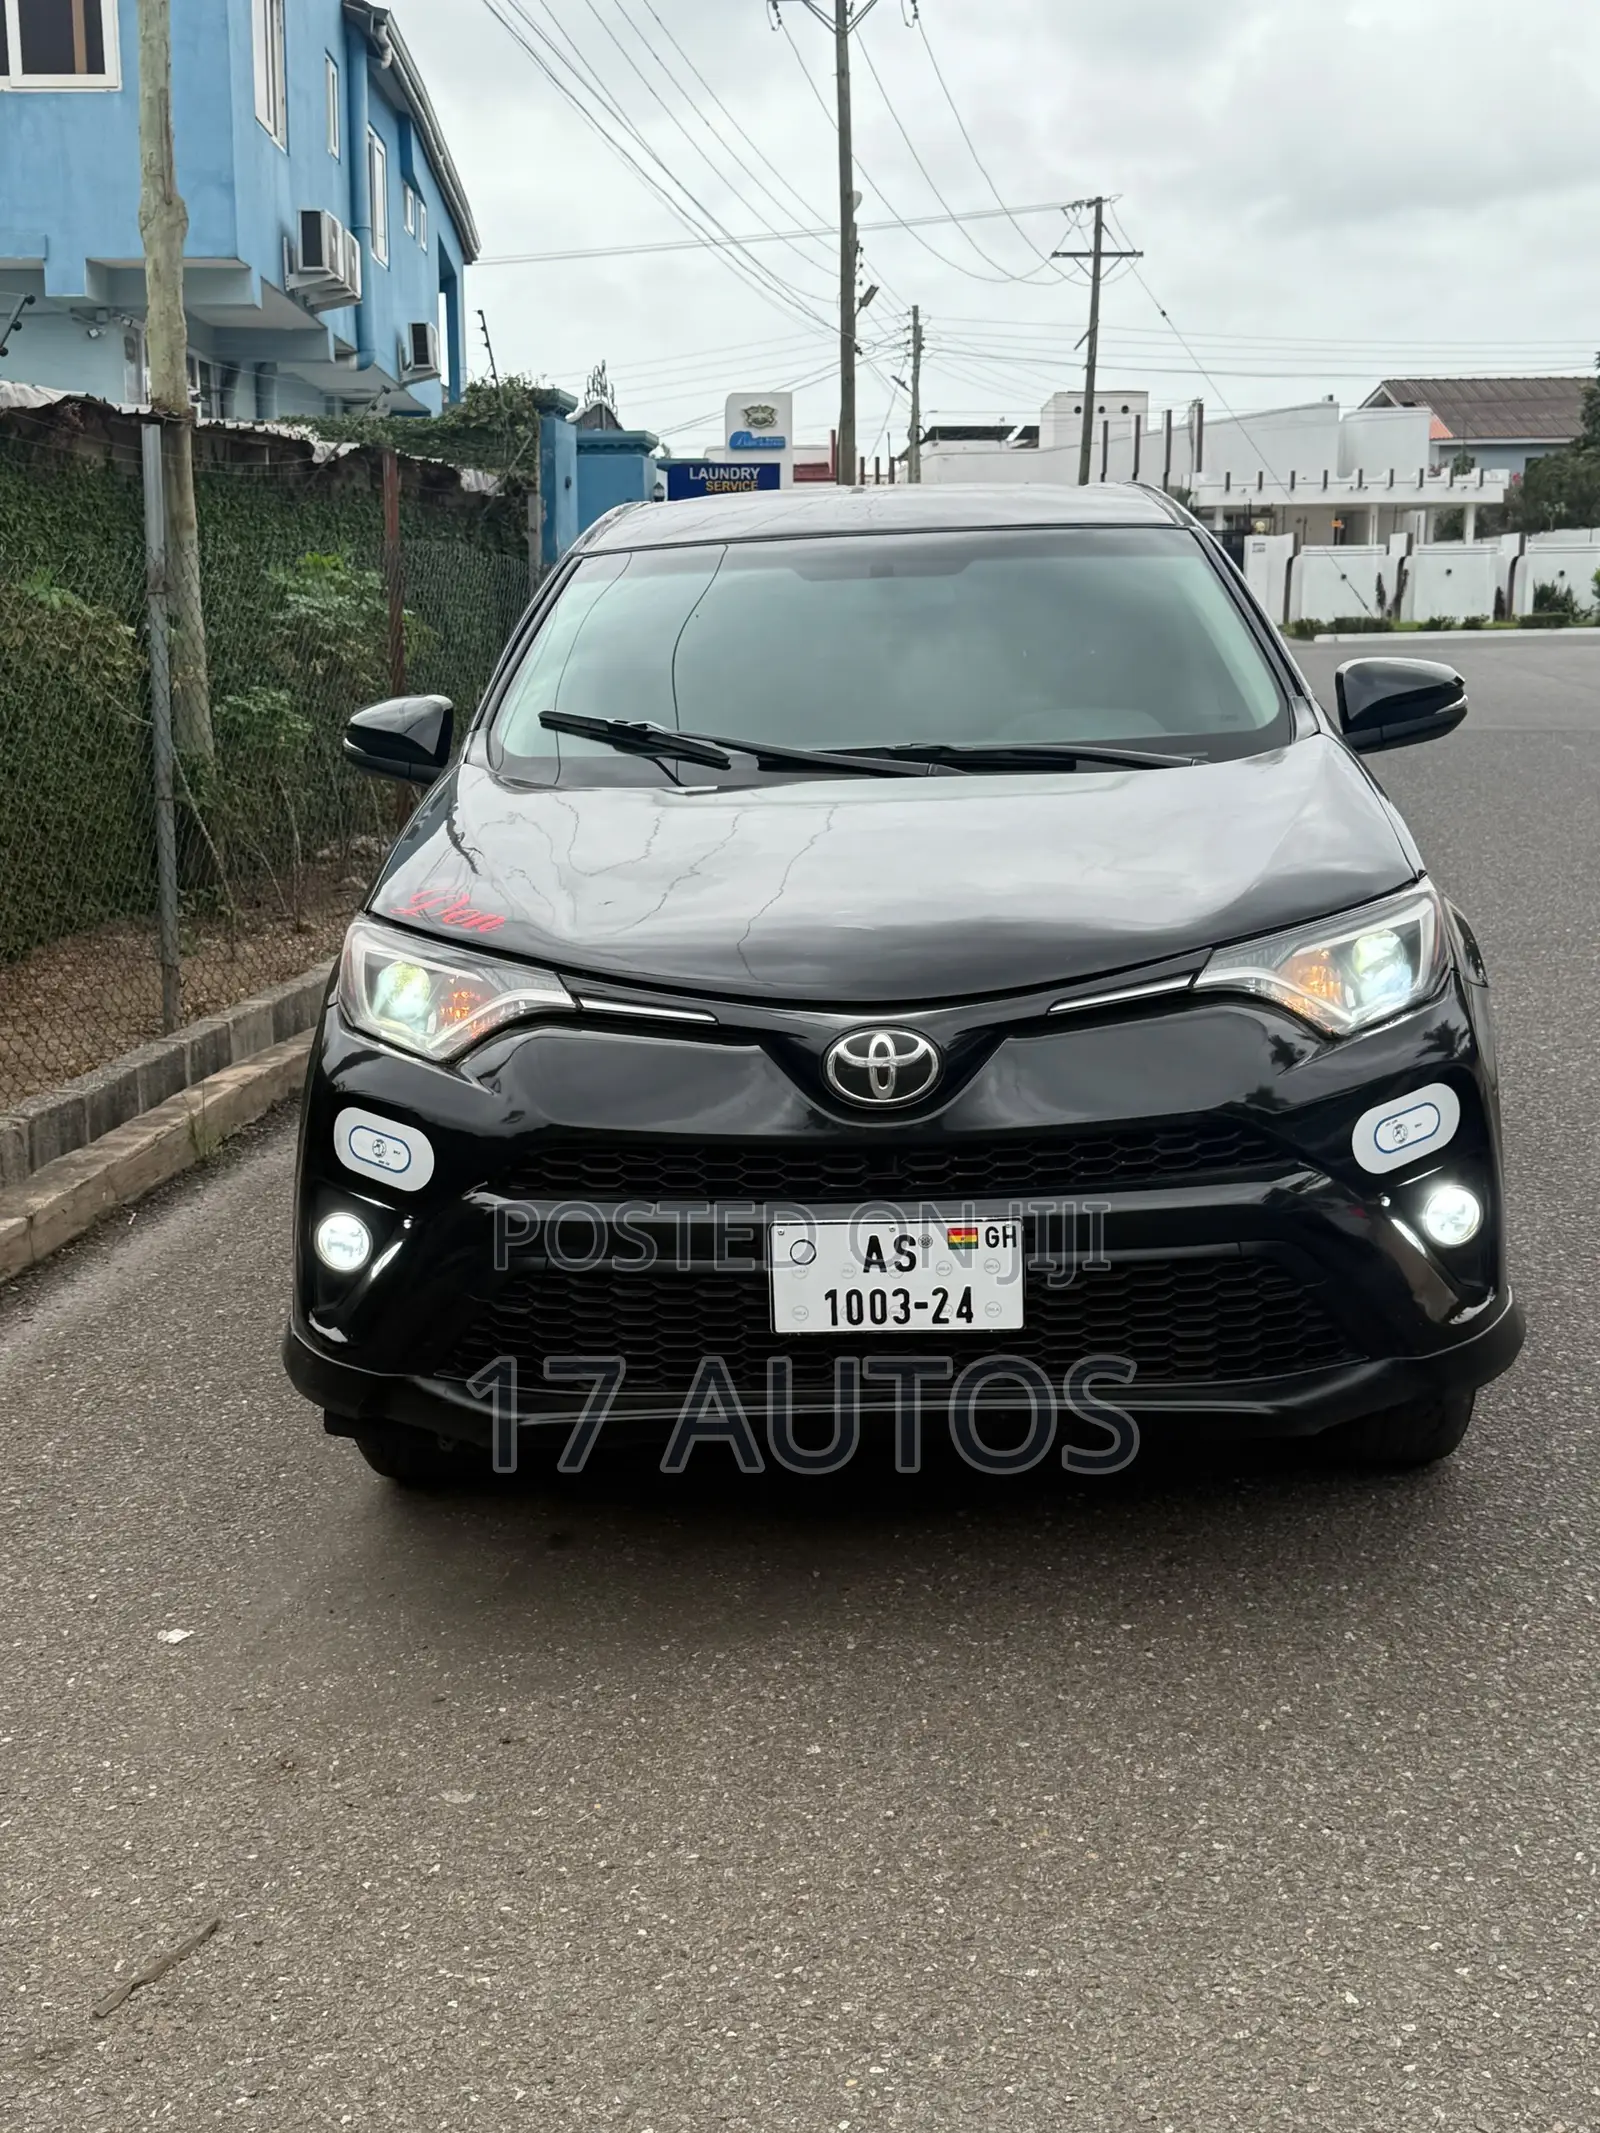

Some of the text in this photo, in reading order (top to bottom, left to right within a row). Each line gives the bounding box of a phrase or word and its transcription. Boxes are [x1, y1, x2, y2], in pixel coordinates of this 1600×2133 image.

[689, 467, 760, 480] LAUNDRY
[705, 480, 758, 491] SERVICE
[984, 1225, 1018, 1249] GH
[863, 1234, 917, 1273] AS
[824, 1286, 974, 1326] 1003-24
